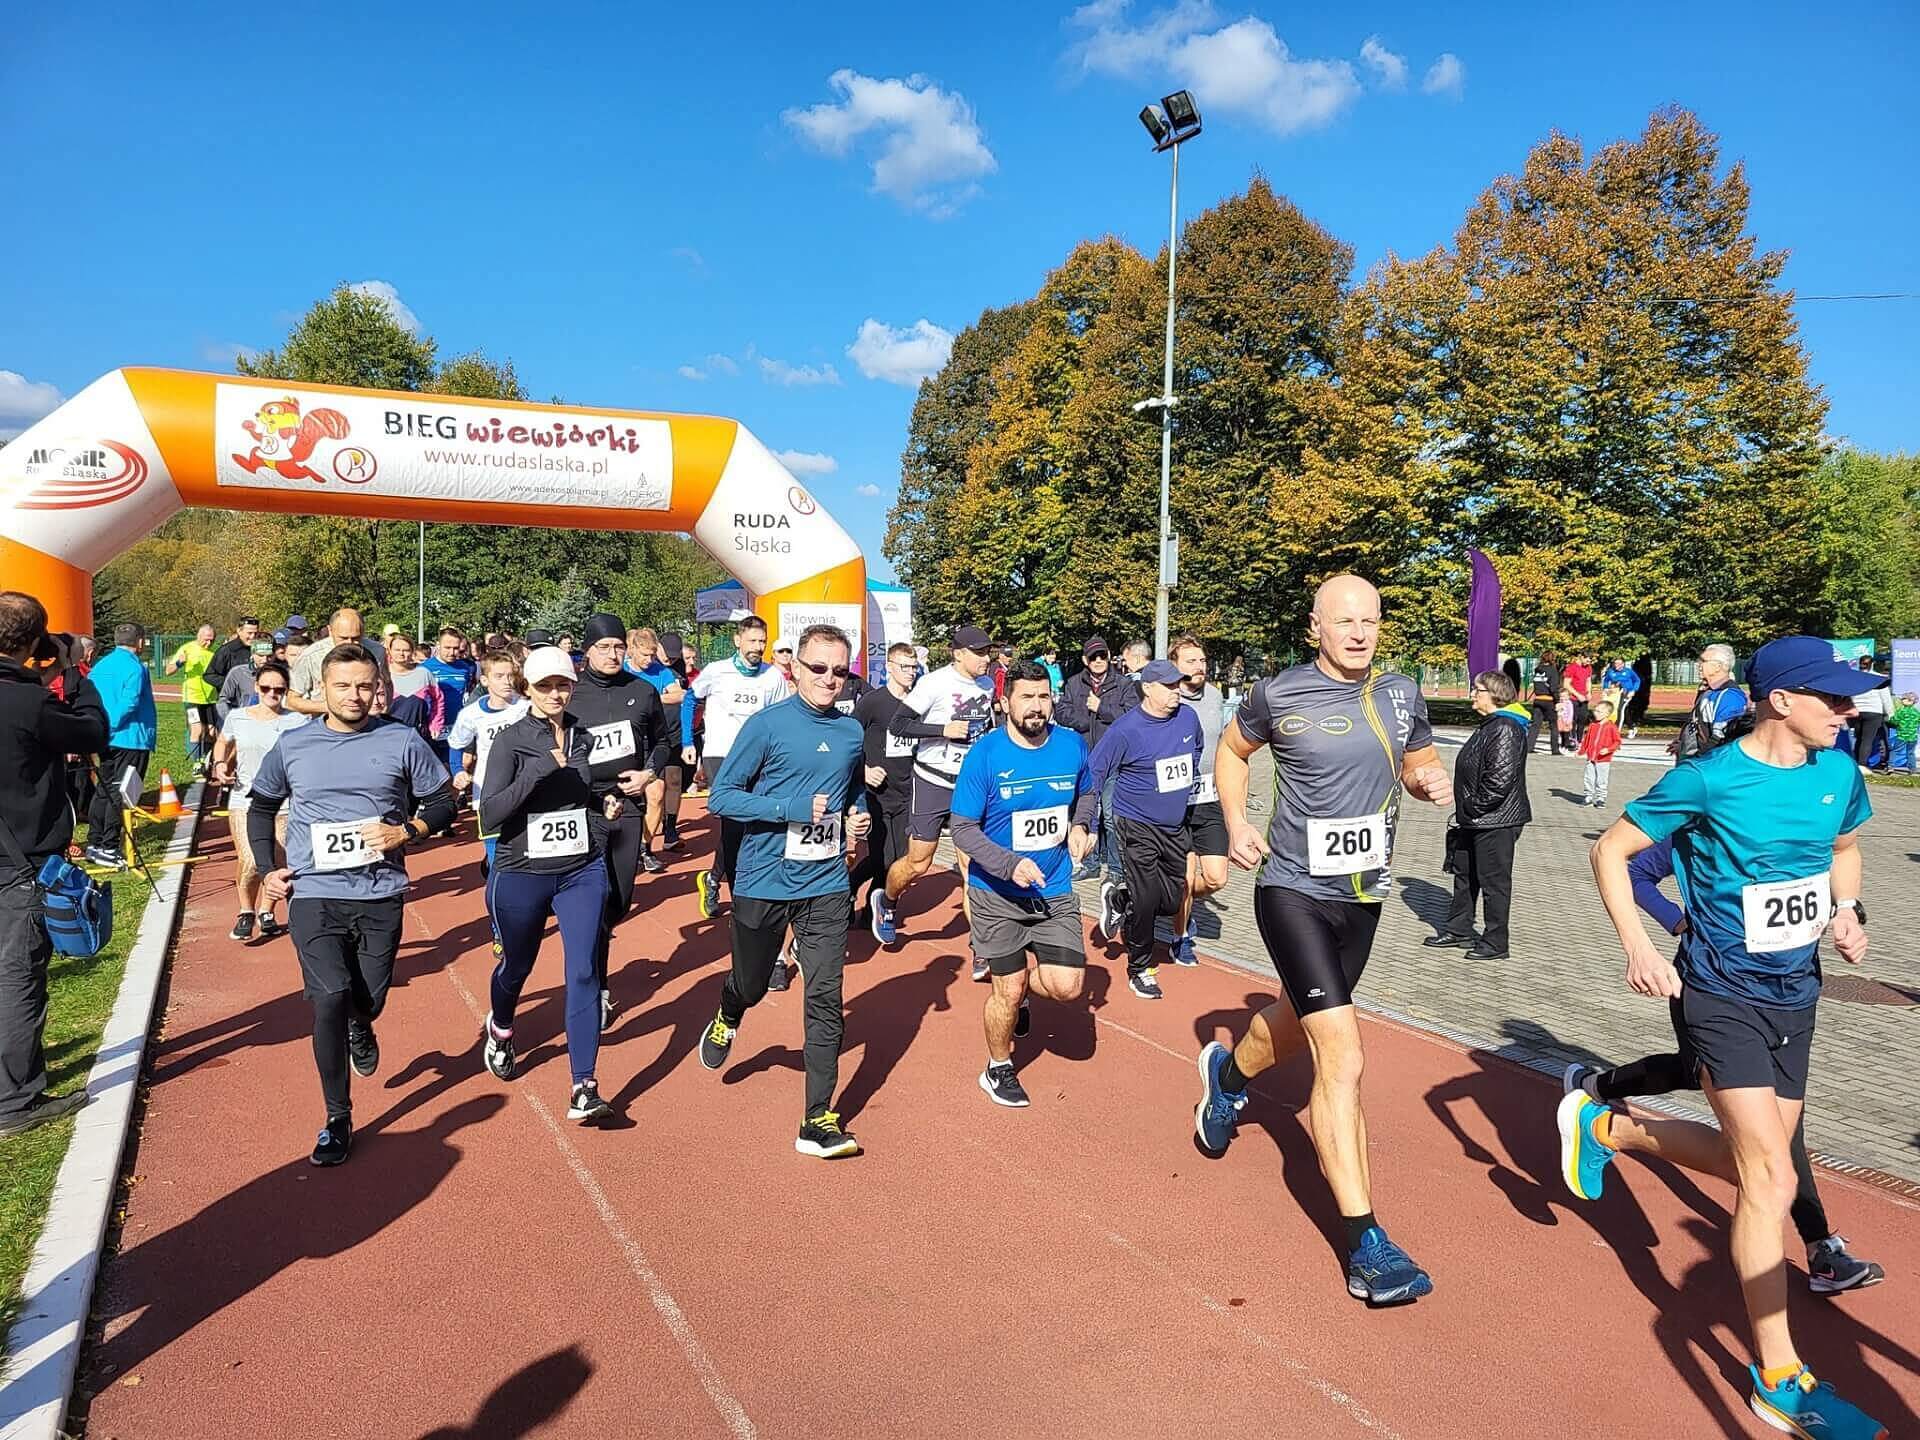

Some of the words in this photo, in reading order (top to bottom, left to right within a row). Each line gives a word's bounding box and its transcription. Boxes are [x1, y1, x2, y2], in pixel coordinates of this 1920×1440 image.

[384, 411, 457, 440] BIEG
[466, 417, 640, 454] wiewiórki
[424, 449, 609, 477] www.rudaslaska.pl
[734, 513, 791, 529] RUDA
[734, 532, 791, 556] Śląska
[734, 693, 758, 705] 239
[594, 730, 622, 750] 217
[1165, 762, 1188, 781] 219
[541, 820, 578, 842] 258
[800, 822, 834, 846] 234
[1024, 816, 1058, 838] 206
[326, 831, 365, 854] 257
[1325, 828, 1372, 857] 260
[1764, 891, 1818, 929] 266
